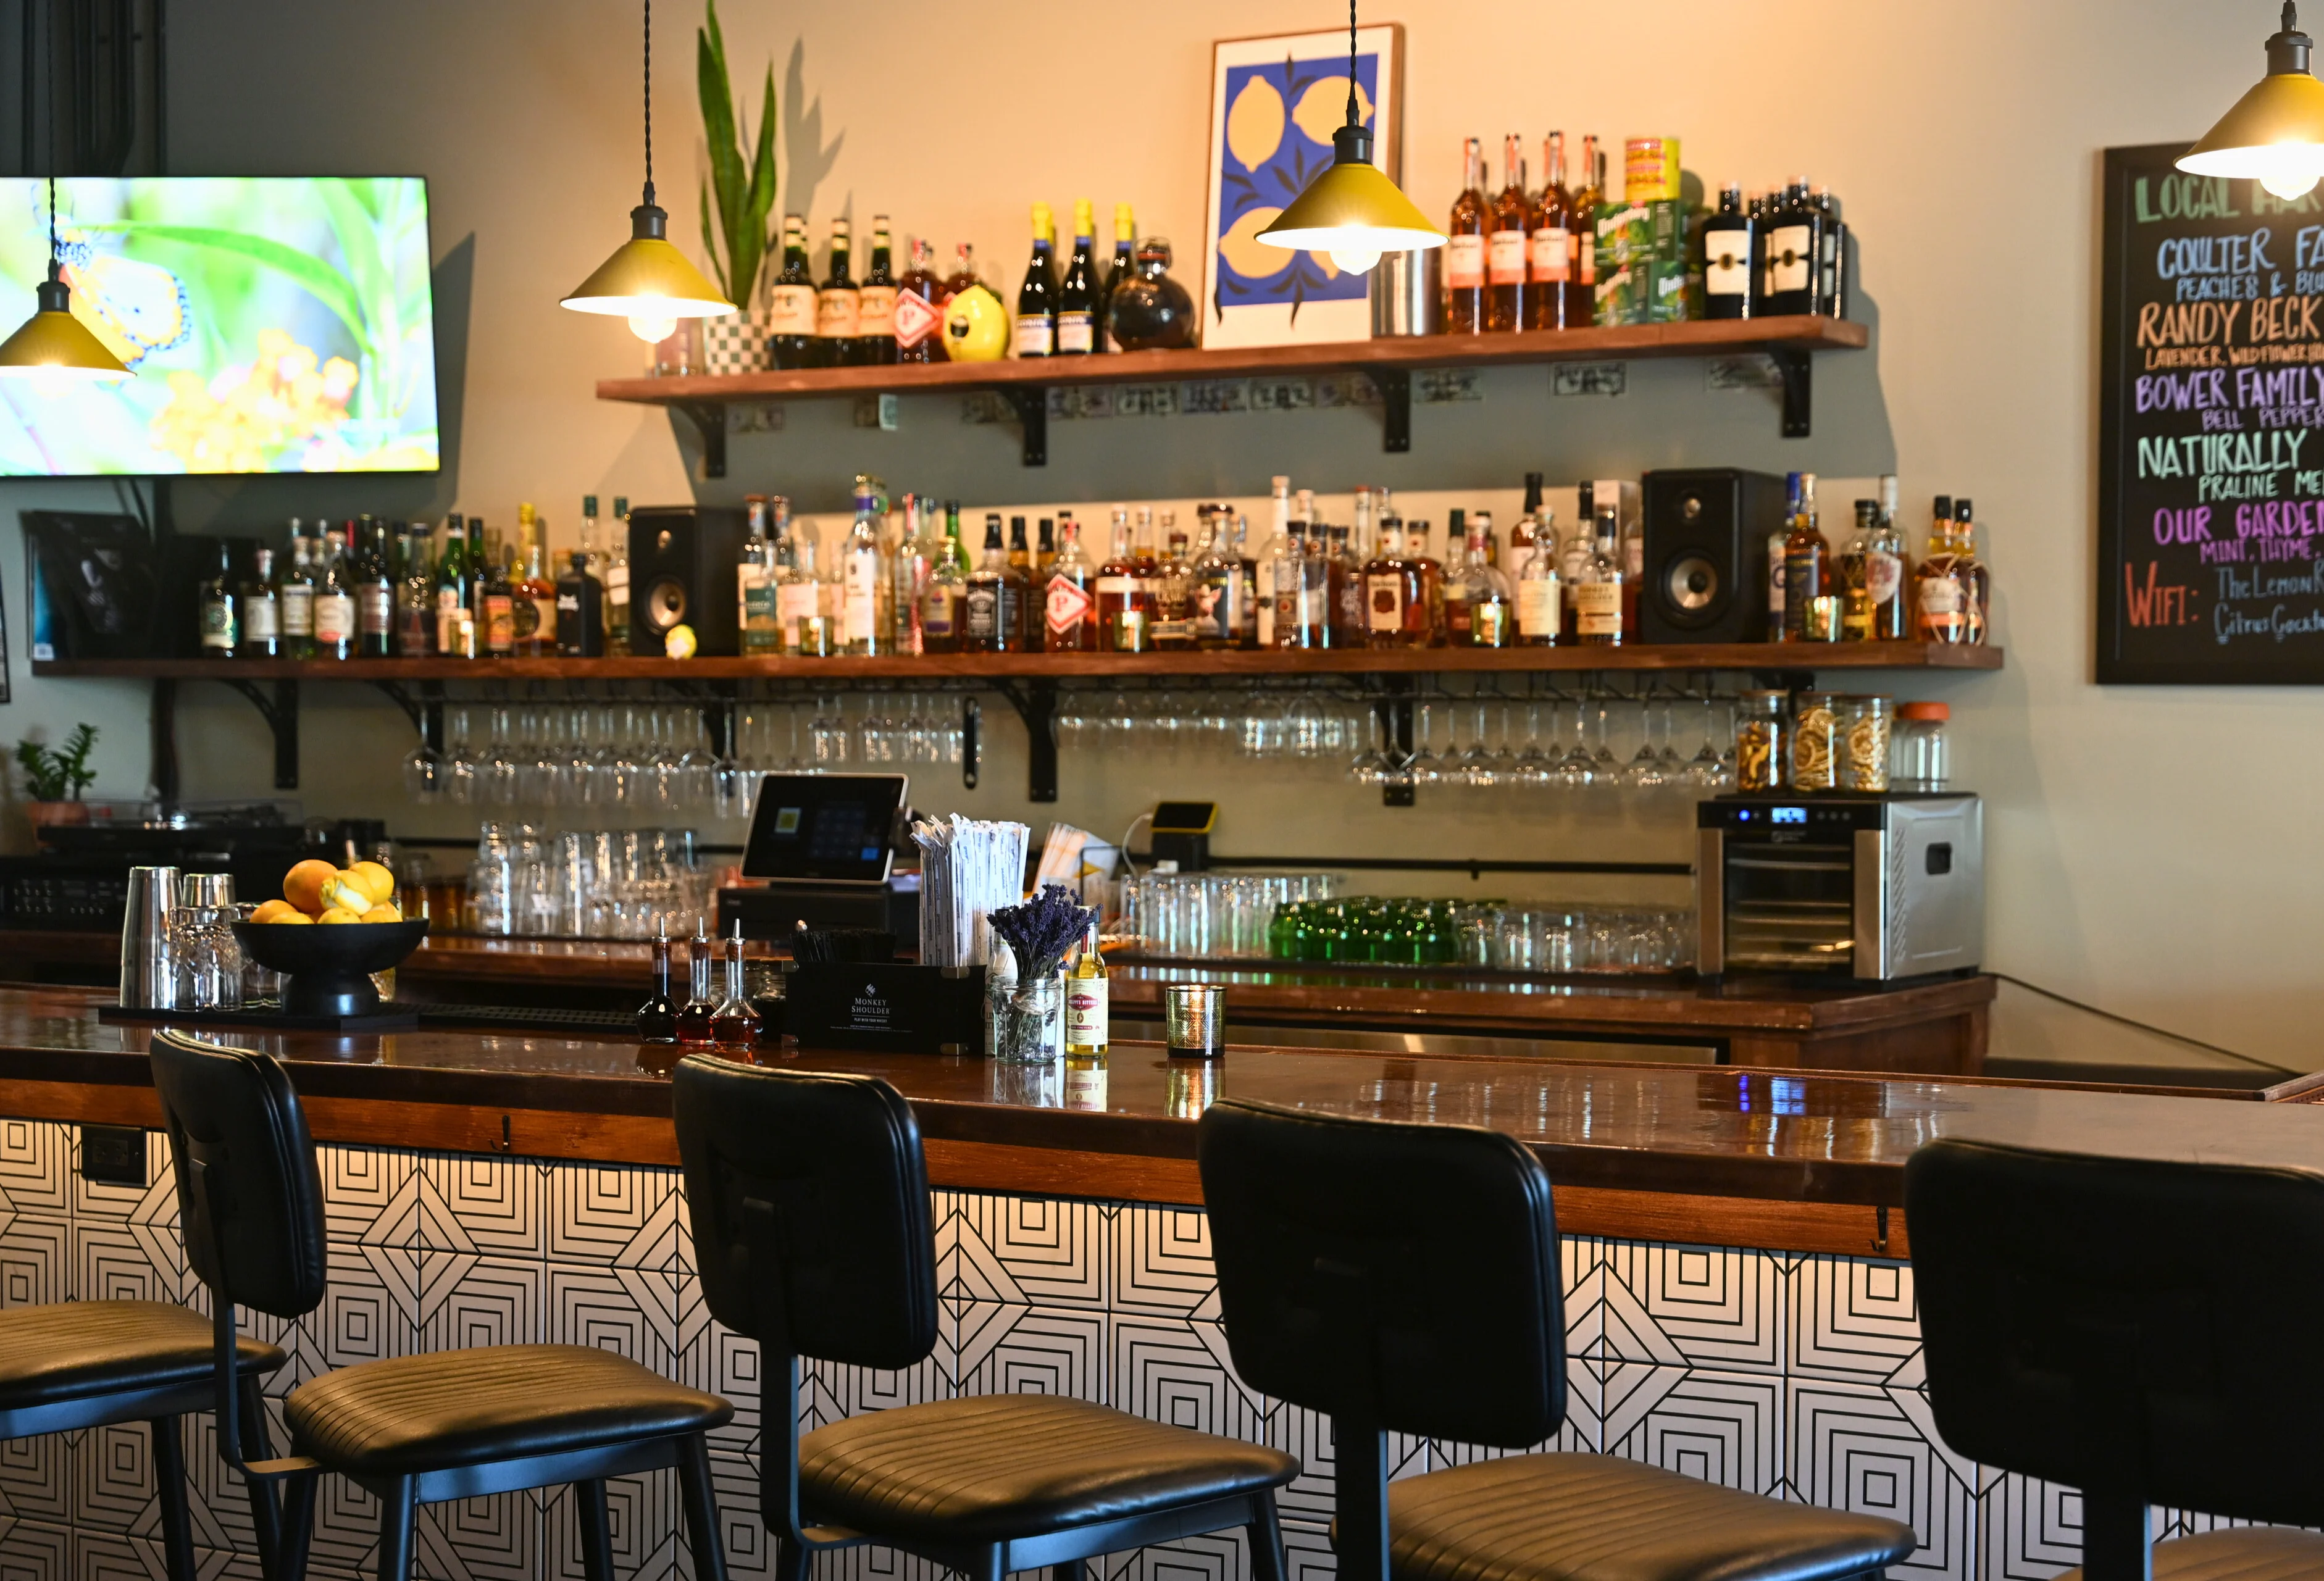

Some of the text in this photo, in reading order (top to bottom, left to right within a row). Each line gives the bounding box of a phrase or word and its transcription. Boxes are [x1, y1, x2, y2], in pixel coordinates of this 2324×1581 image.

[2134, 172, 2241, 224] LOCAL
[2157, 227, 2276, 280] COULTER
[2175, 275, 2260, 303] PEACHES
[2270, 270, 2288, 297] &
[2136, 295, 2322, 348] RANDY BECK
[2135, 366, 2324, 414] BOWER FAMILY
[2202, 408, 2245, 432] BELL
[2138, 428, 2308, 480] NATURALLY
[2198, 472, 2280, 504] PRALINE
[2153, 505, 2213, 546] OUR
[851, 1005, 890, 1014] SHOULDER
[855, 998, 887, 1006] MONKEY
